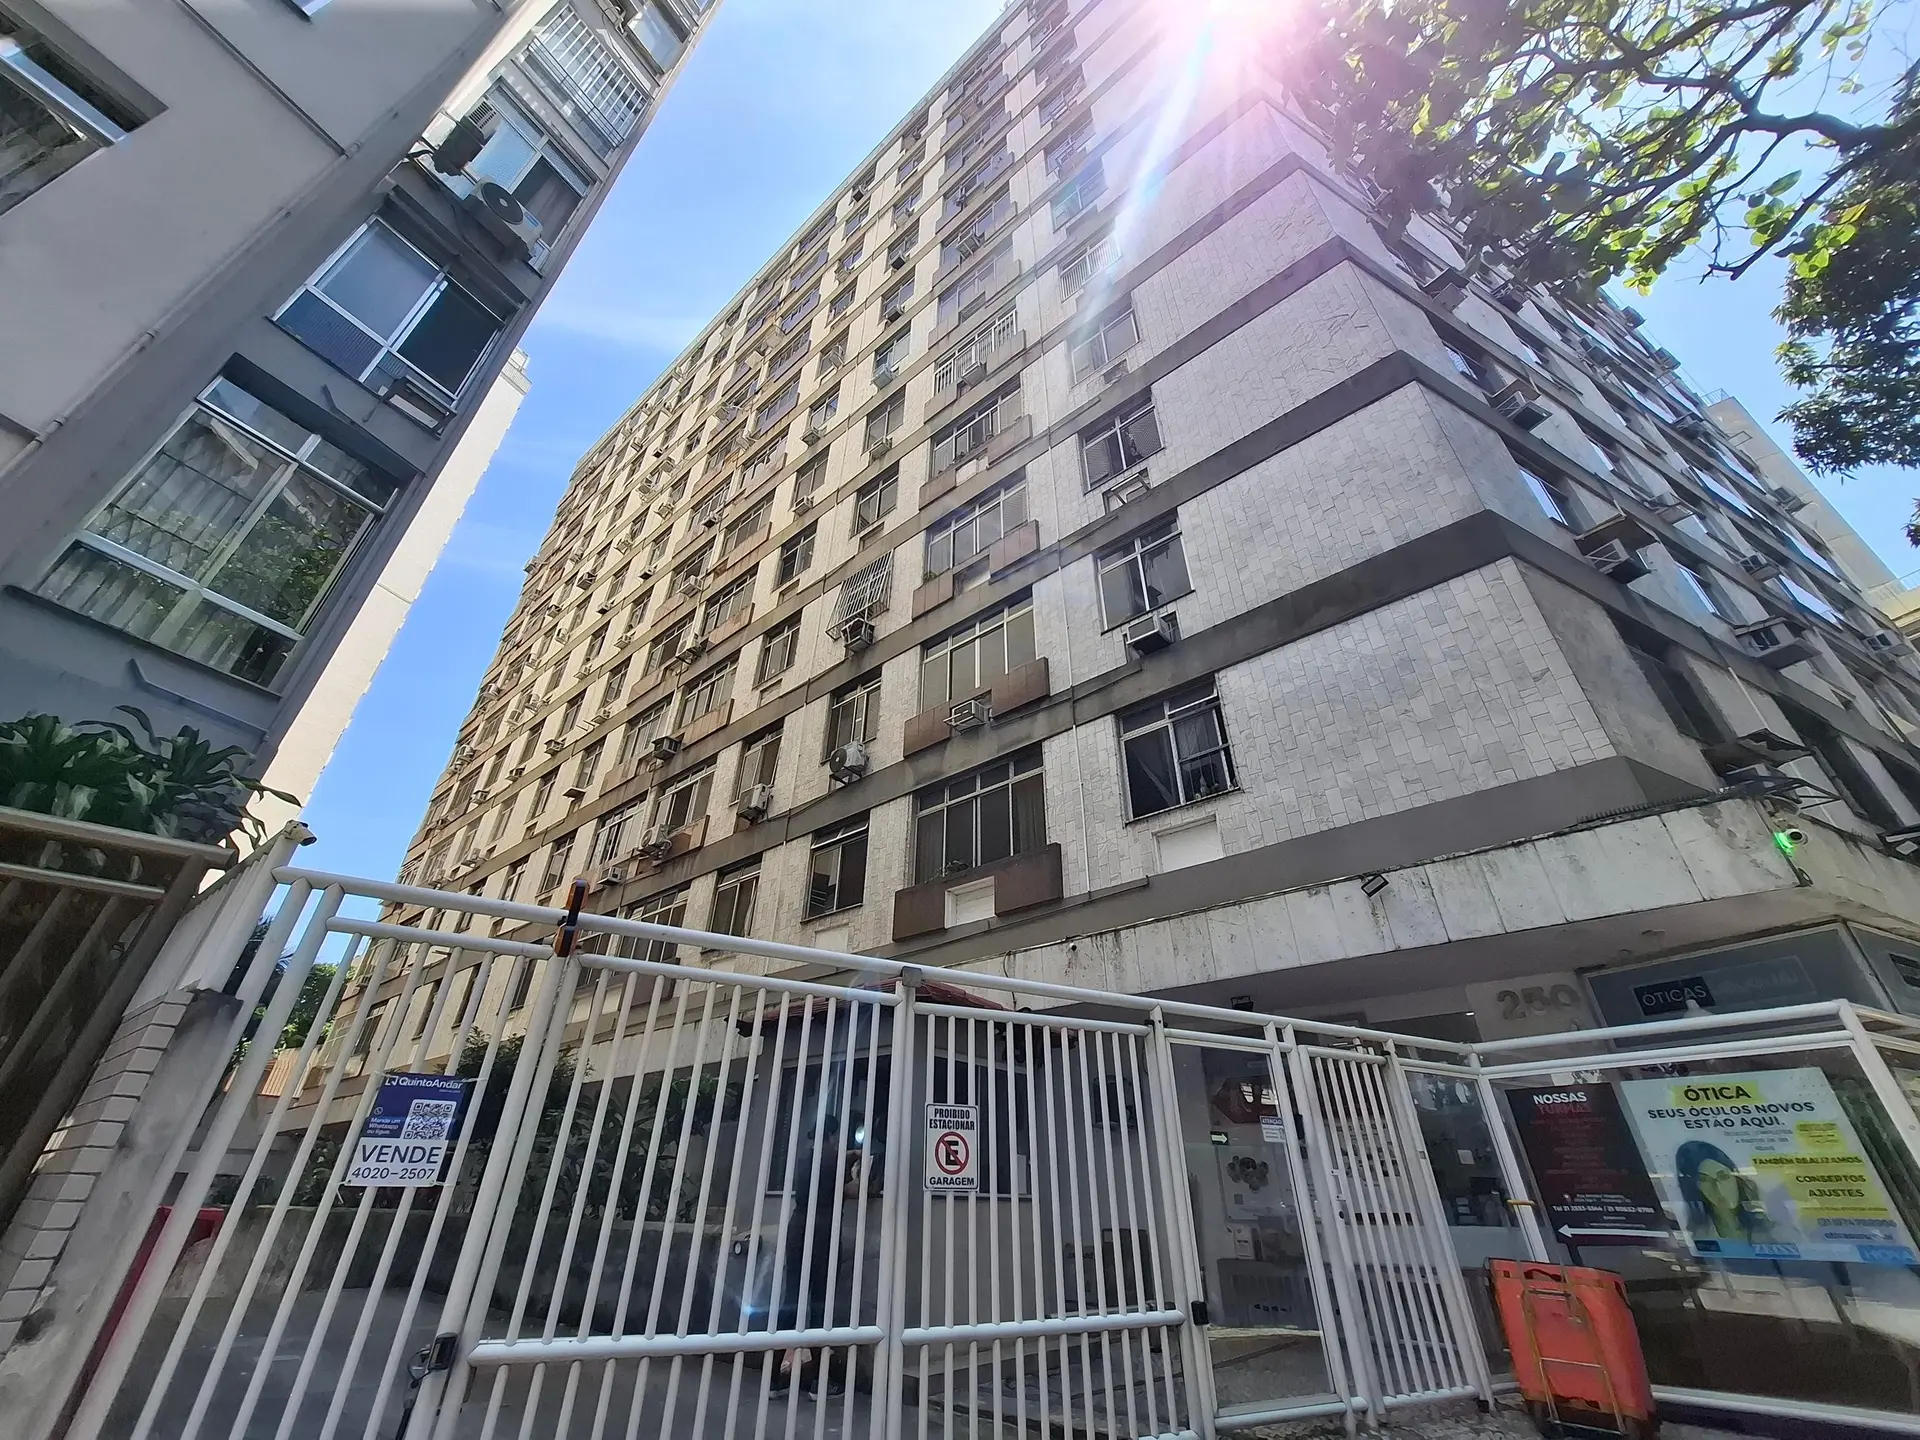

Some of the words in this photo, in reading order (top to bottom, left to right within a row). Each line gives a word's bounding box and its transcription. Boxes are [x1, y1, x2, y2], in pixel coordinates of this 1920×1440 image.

[1642, 985, 1707, 1008] ÓTICAS
[399, 1076, 463, 1089] QuintoAndar
[1533, 1091, 1587, 1104] NOSSAS
[1684, 1085, 1752, 1101] ÓTICA
[934, 1108, 970, 1119] PROIBIDO
[1648, 1107, 1686, 1119] SEUS
[1689, 1105, 1750, 1117] ÓCULOS
[1755, 1102, 1815, 1114] NOVOS
[929, 1119, 975, 1130] ESTACIONAR
[1684, 1116, 1735, 1129] ESTÃO
[1740, 1116, 1785, 1129] AQUI.
[362, 1145, 442, 1164] VENDE
[945, 1141, 959, 1166] E
[1752, 1157, 1794, 1165] TAMBÉM
[351, 1167, 435, 1180] 4020-2507
[1796, 1175, 1866, 1183] CONSERTOS
[929, 1177, 974, 1186] GARAGEM
[1809, 1189, 1865, 1197] AJUSTES
